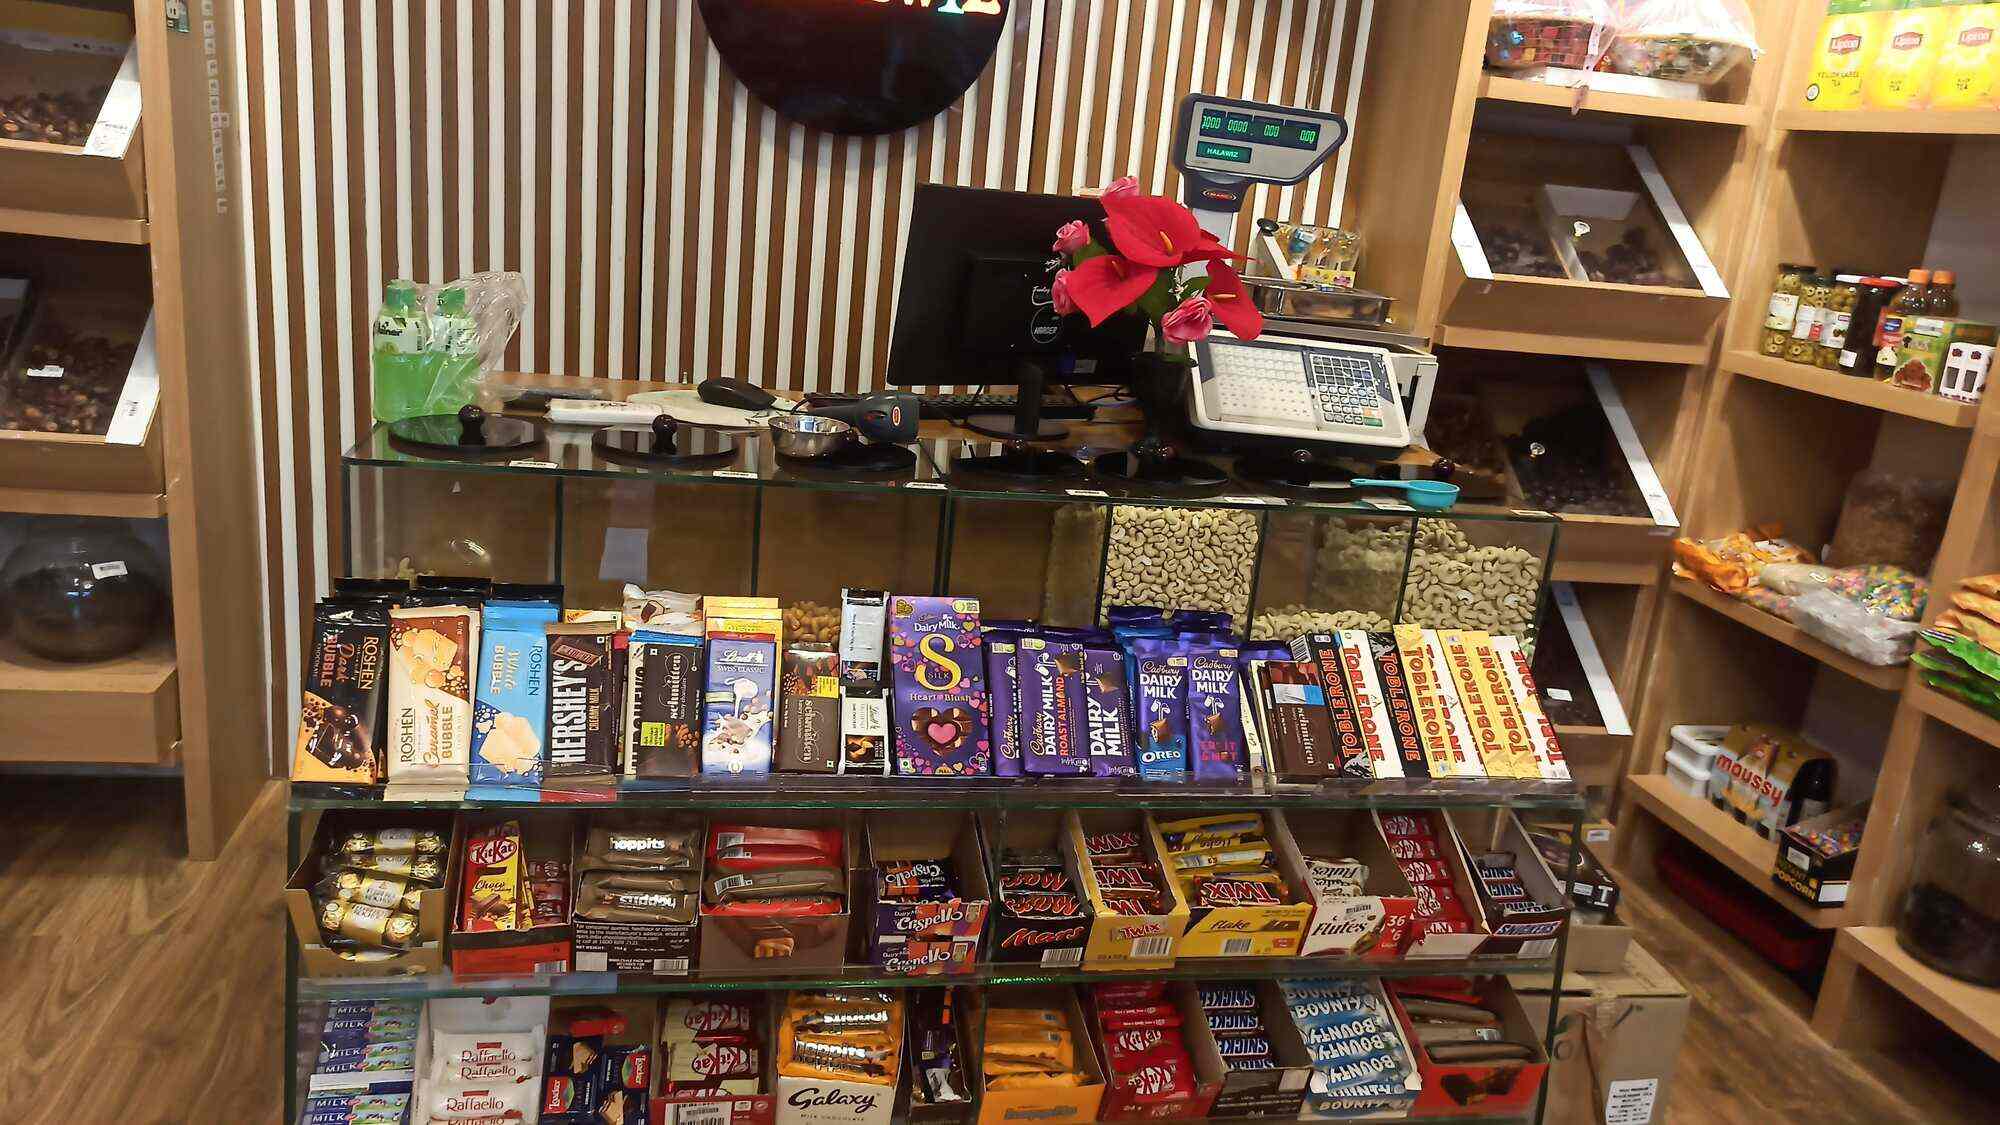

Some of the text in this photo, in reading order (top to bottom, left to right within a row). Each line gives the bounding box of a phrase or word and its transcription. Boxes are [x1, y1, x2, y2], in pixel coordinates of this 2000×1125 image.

[914, 620, 959, 632] Dairy Milk
[320, 634, 337, 688] BUBBLE
[360, 637, 380, 690] ROSHEN
[490, 645, 505, 695] BUBBLE
[505, 650, 520, 692] White
[528, 645, 543, 696] ROSHEN
[1142, 661, 1180, 676] Cadbury
[1194, 657, 1232, 670] Cadbury
[1140, 674, 1182, 687] DAIRY
[1191, 670, 1234, 682] DAIRY
[910, 693, 972, 702] Heart Blush
[1144, 686, 1177, 699] MILK
[1196, 682, 1230, 694] MILK
[1450, 645, 1502, 754] TOBLERONE
[552, 660, 587, 763] HERSHEY'S
[589, 688, 600, 731] CREAMY MILK
[1319, 649, 1363, 758] TOBLERONE
[1379, 652, 1421, 761] TOBLERONE
[1404, 647, 1448, 763] TOBLERONE
[1475, 646, 1529, 755] TOBLERONE
[1042, 675, 1057, 756] DAIRY MILK
[1087, 697, 1107, 756] DAIRY
[400, 707, 415, 763] ROSHEN
[423, 700, 440, 768] Caramel
[442, 706, 453, 759] BUBBLE
[1000, 715, 1016, 759] Cadbury
[1030, 712, 1045, 756] Cadbury
[1058, 721, 1069, 757] ROAST
[1103, 707, 1122, 756] MILK
[1142, 750, 1181, 763] OREO
[1716, 754, 1783, 808] moussy
[470, 840, 517, 865] KitKat
[609, 836, 666, 851] hoppits
[1086, 832, 1138, 853] WIX
[475, 879, 505, 892] Choco
[885, 863, 941, 886] Crispello
[1203, 882, 1281, 905] TWIX
[896, 908, 964, 931] Crispello
[1311, 920, 1367, 937] Flutes
[1387, 915, 1406, 927] 36
[1001, 926, 1085, 949] Mars
[337, 1006, 369, 1015] MILK
[1297, 996, 1362, 1019] BOUNTY
[334, 1020, 366, 1030] MILK
[1208, 1014, 1258, 1030] SNICKE
[1310, 1017, 1376, 1044] BOUNTY
[461, 1049, 517, 1064] Raffaello
[1319, 1034, 1386, 1061] BOUNTY
[325, 1063, 358, 1074] MILK
[692, 1043, 749, 1077] KitKat
[1330, 1054, 1396, 1084] BOUNTY
[460, 1066, 517, 1080] Raffaello
[316, 1098, 350, 1108] MILK
[446, 1097, 504, 1112] Raffaello
[788, 1087, 879, 1114] Galaxy
[1319, 1099, 1389, 1111] BOUNTY
[312, 1113, 346, 1123] MILK
